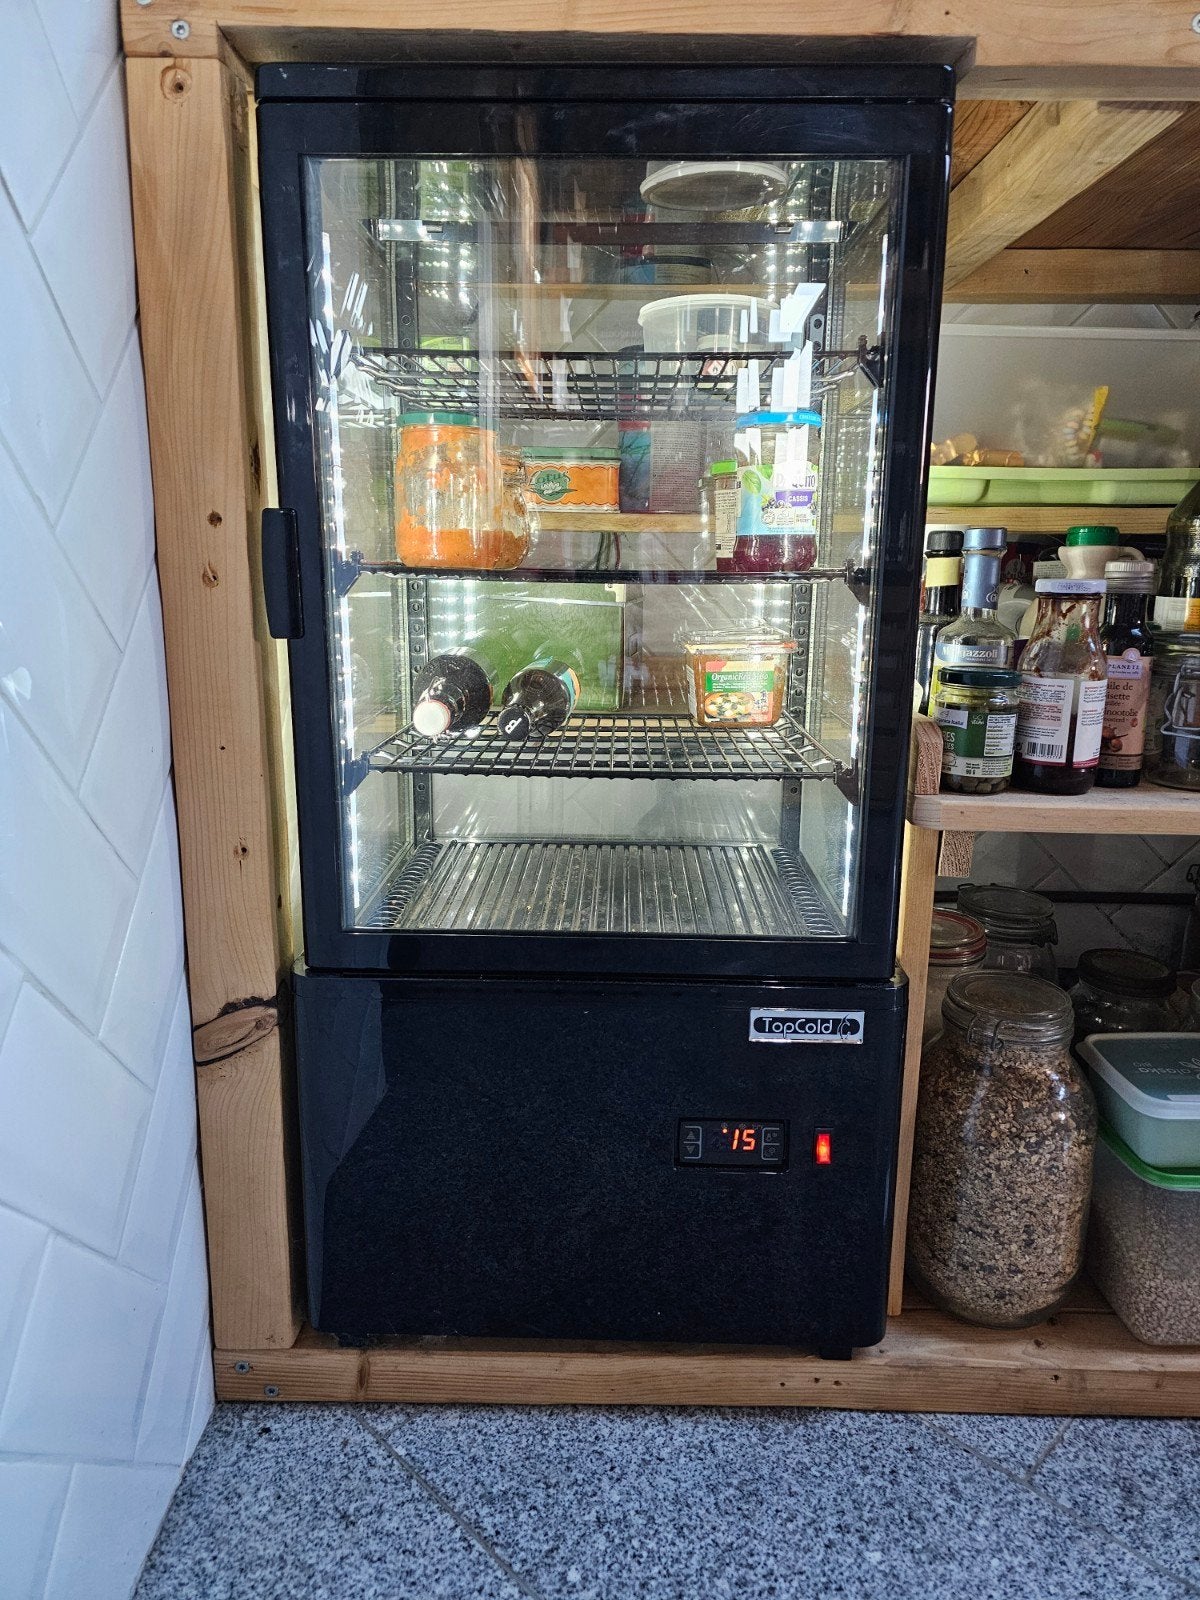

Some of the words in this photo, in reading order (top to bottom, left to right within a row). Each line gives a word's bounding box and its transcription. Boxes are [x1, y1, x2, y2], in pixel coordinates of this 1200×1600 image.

[942, 646, 998, 658] Mgazzoli
[1123, 682, 1133, 690] de
[1106, 692, 1130, 701] isette
[1104, 707, 1138, 717] lnootolie
[762, 1017, 833, 1040] TopCold
[732, 1128, 756, 1151] 15
